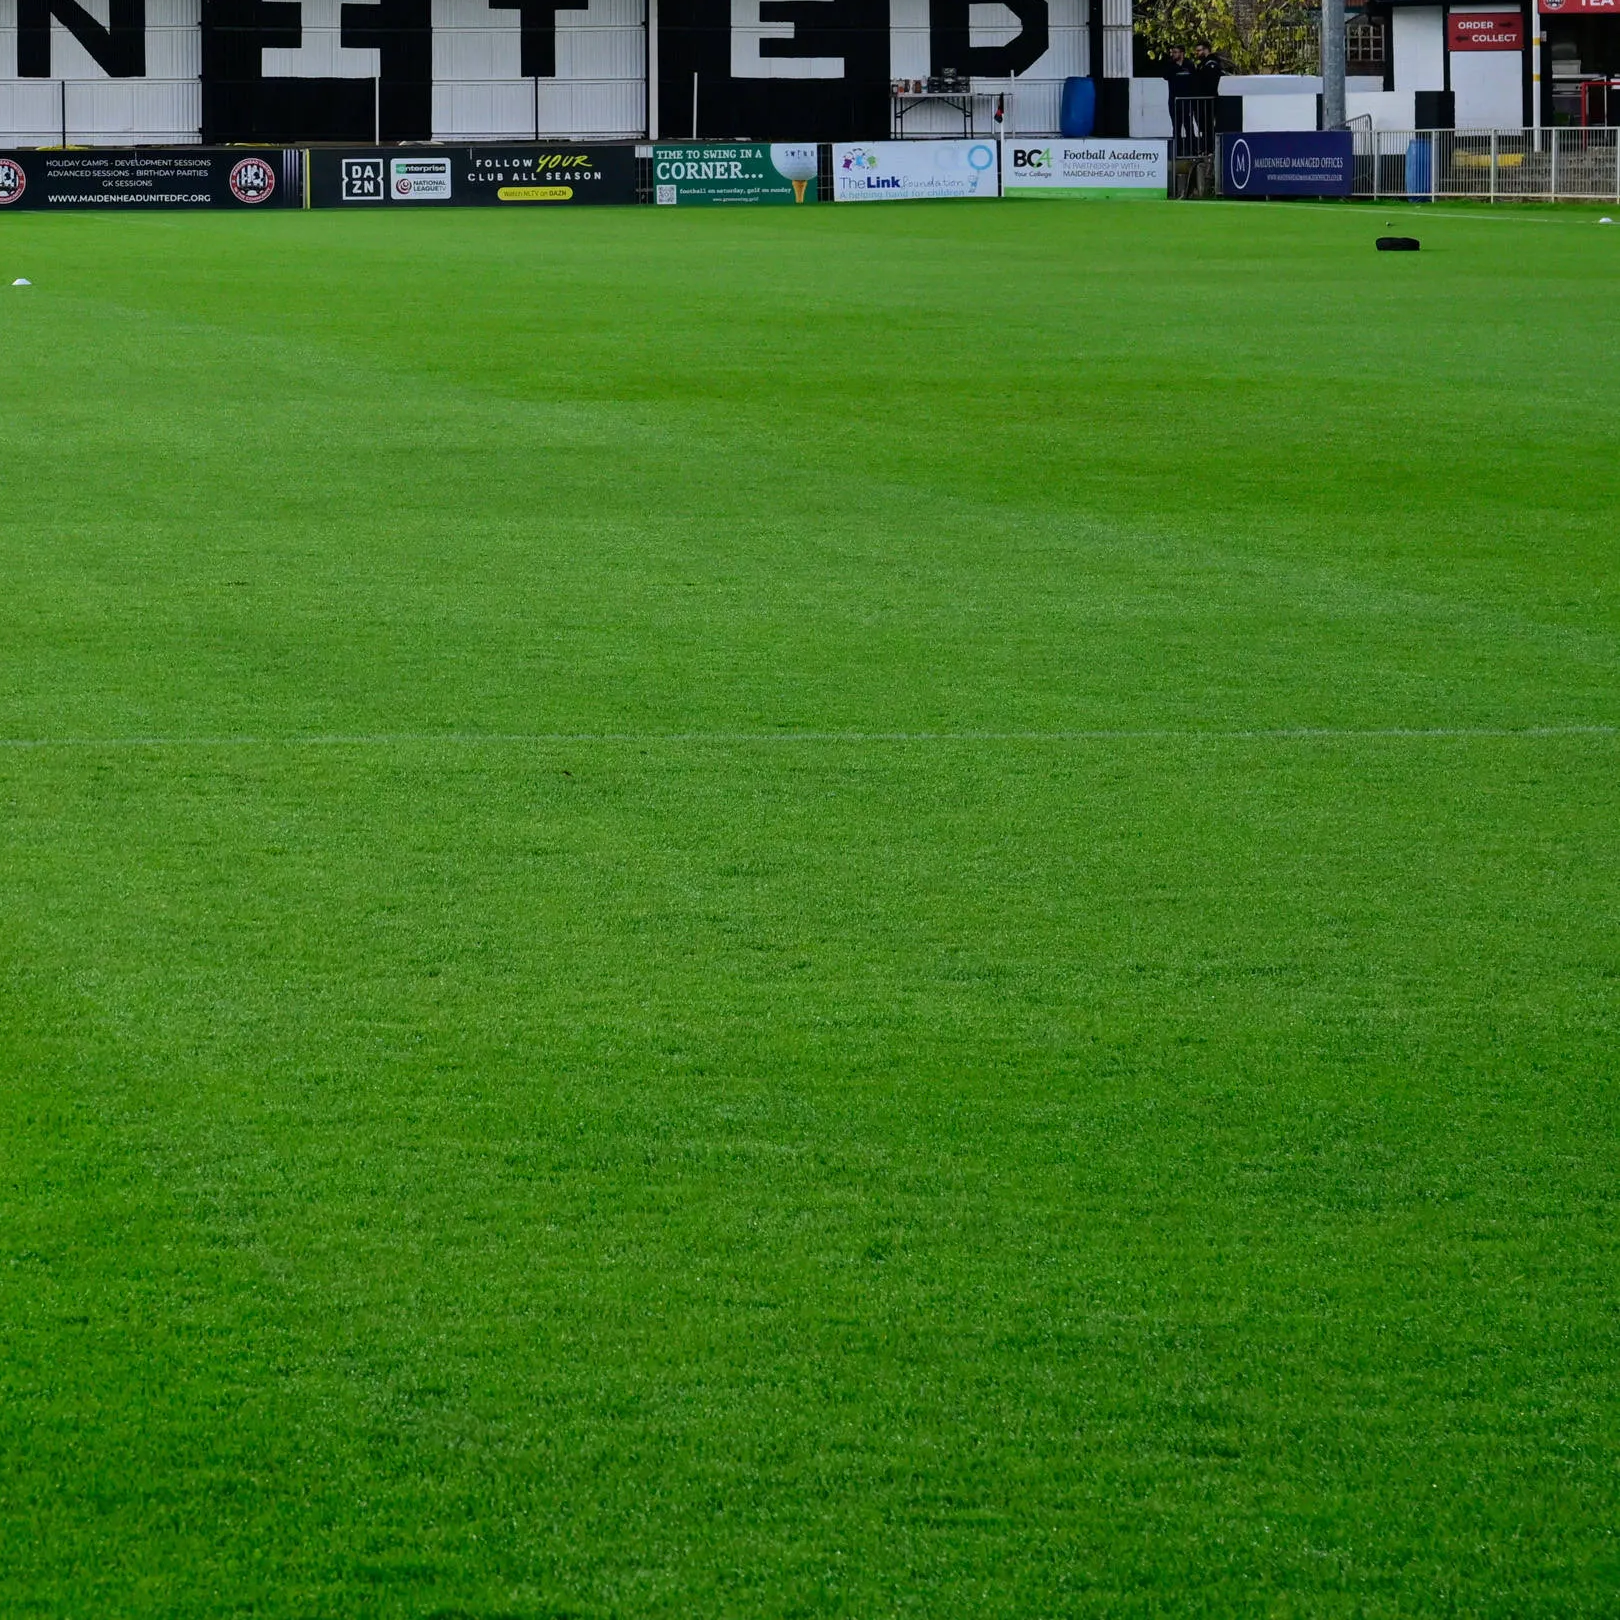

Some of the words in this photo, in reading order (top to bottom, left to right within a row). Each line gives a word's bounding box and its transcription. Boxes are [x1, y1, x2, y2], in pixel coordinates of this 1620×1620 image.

[1458, 21, 1494, 29] ORDER
[1471, 34, 1517, 42] COLLECT
[656, 150, 683, 159] TIME
[686, 150, 700, 159] TO
[703, 150, 737, 159] SWING
[740, 149, 752, 158] IN
[755, 149, 763, 158] A
[1013, 148, 1052, 168] BCA
[1063, 150, 1105, 160] Football
[1109, 150, 1159, 163] Academy
[46, 159, 80, 167] HOLIDAY
[81, 159, 108, 167] CAMPS
[115, 159, 172, 167] DEVELOPMENT
[174, 159, 211, 167] SESSIONS
[476, 159, 533, 167] FOLLOW
[536, 154, 593, 172] YOUR
[1236, 154, 1245, 172] M
[1254, 158, 1291, 168] MAIDENHEAD
[1291, 157, 1320, 168] MANAGED
[1321, 157, 1343, 168] OFFICES
[136, 169, 175, 177] BIRTHDAY
[176, 169, 208, 177] PARTIES
[656, 162, 764, 180] CORNER...
[468, 173, 503, 181] CLUB
[512, 172, 537, 181] ALL
[546, 172, 602, 180] SEASON
[48, 194, 211, 202] WWW.MAIDENHEADUNITEDFC.ORG
[849, 191, 882, 200] helping
[885, 190, 908, 198] hand
[911, 189, 924, 197] for
